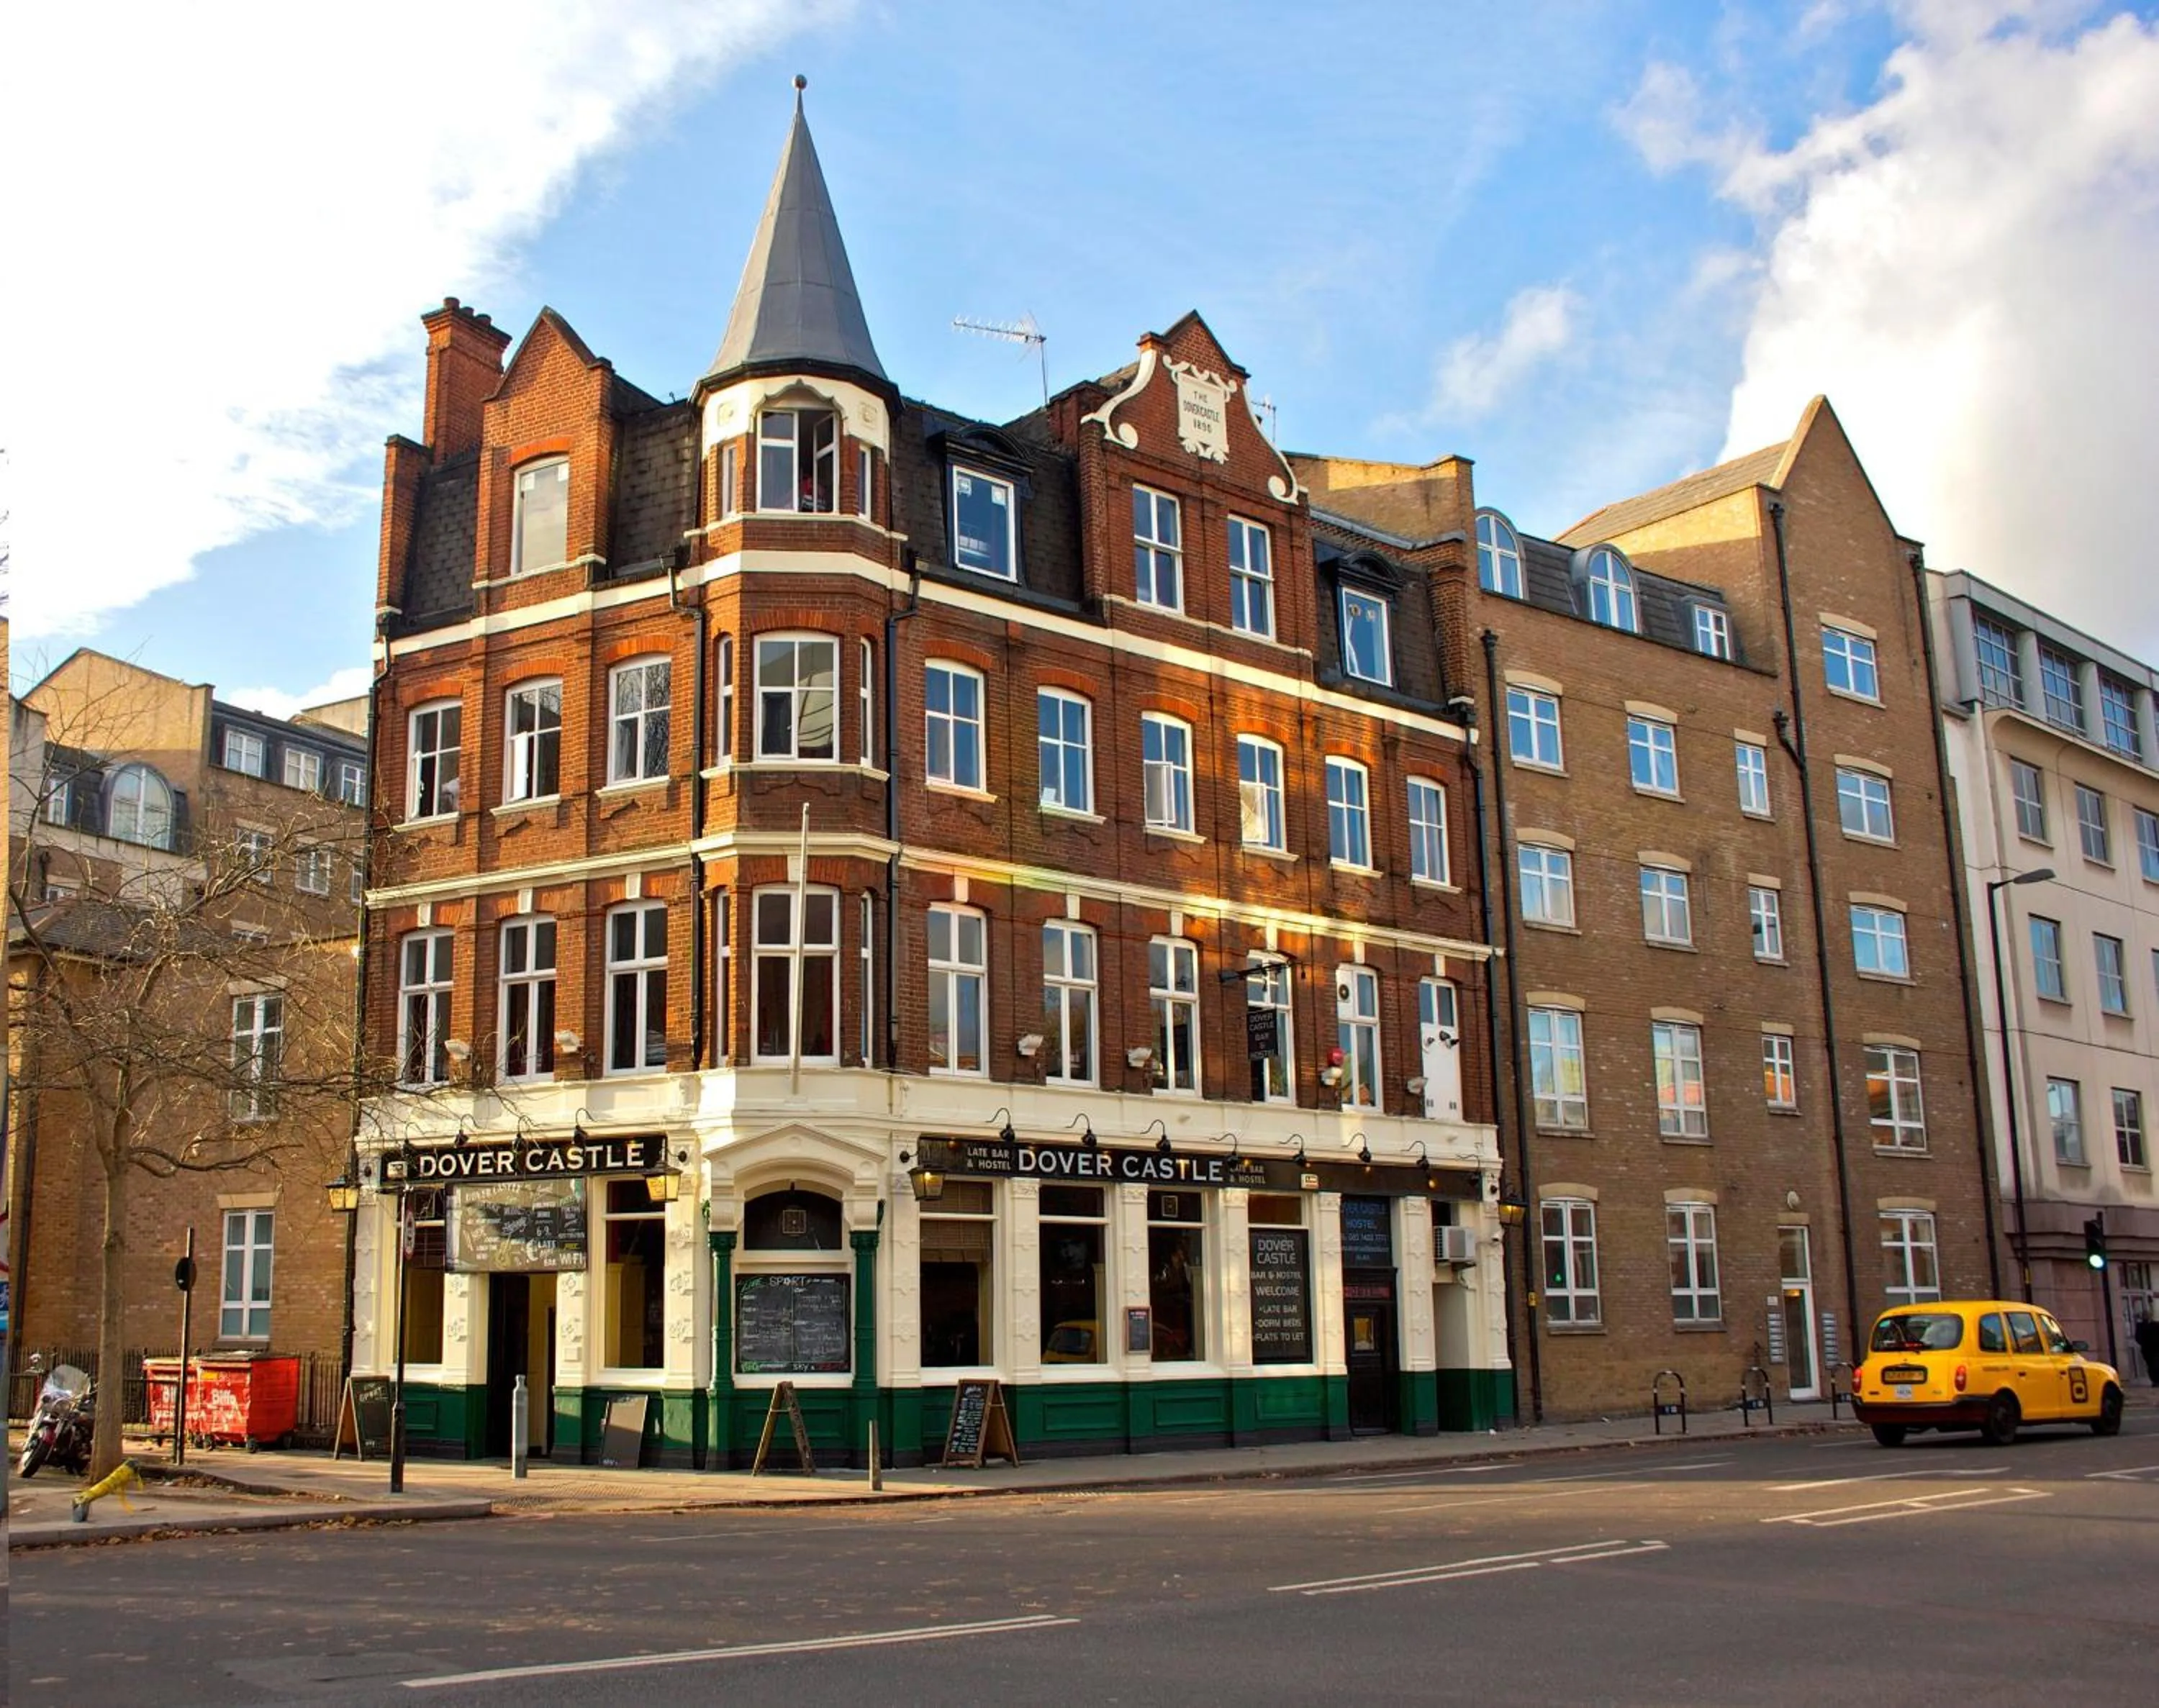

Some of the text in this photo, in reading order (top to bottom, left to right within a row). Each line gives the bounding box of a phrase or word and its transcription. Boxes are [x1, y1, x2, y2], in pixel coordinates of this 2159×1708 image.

[967, 1147, 1010, 1159] LATE BAR
[420, 1143, 645, 1177] DOVER CASTLE
[967, 1160, 1011, 1171] & HOSTEL
[1018, 1149, 1223, 1182] DOVER CASTLE
[1249, 1165, 1264, 1173] BAR
[1239, 1175, 1266, 1184] HOSTEL
[1257, 1239, 1295, 1251] DOVER
[1257, 1253, 1296, 1265] CASTLE
[769, 1276, 807, 1287] SPORT
[1255, 1286, 1300, 1296] WELCOME
[1283, 1305, 1298, 1314] BAR
[1281, 1332, 1290, 1342] TO
[1293, 1332, 1305, 1341] LET
